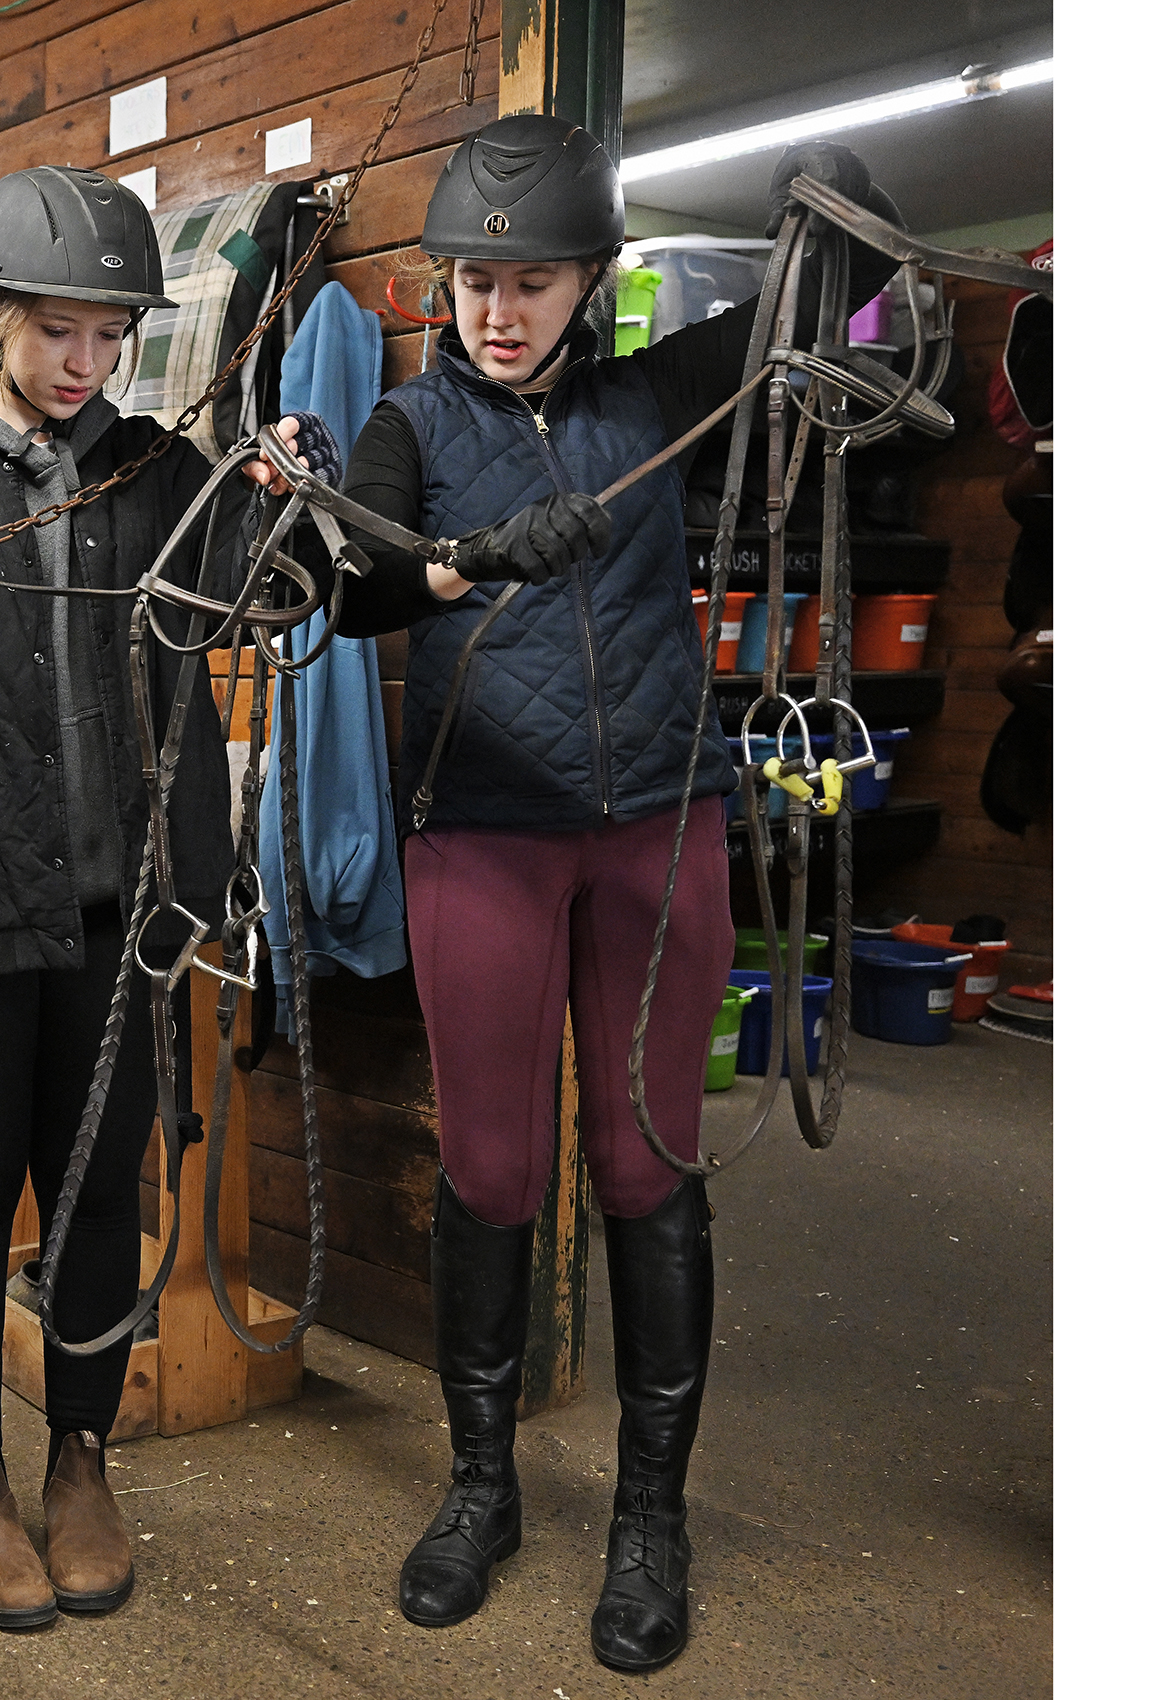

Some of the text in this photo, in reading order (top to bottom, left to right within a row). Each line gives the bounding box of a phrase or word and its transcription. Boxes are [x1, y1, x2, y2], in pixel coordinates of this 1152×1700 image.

[709, 550, 823, 572] BUSH CKET
[719, 695, 749, 715] RUSH
